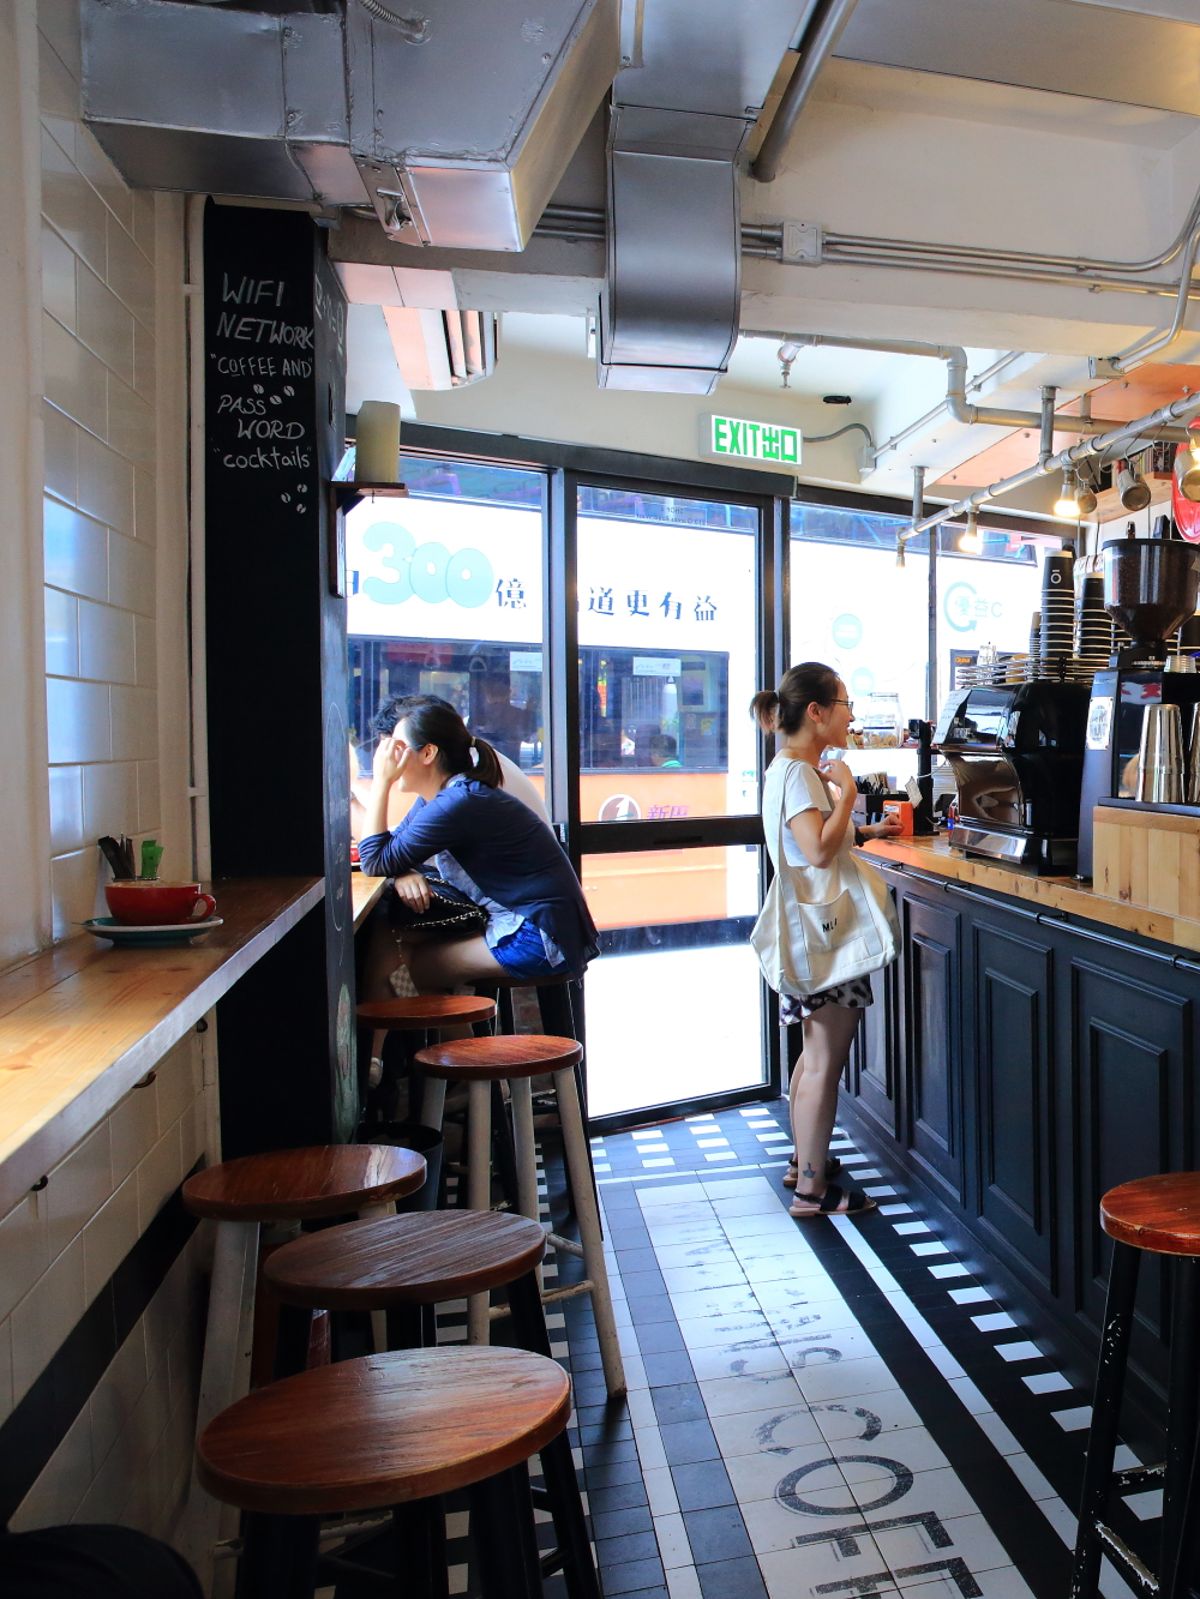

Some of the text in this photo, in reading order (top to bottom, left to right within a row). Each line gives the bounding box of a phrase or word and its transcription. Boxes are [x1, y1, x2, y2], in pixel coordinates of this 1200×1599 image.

[222, 272, 284, 306] WIFI
[216, 312, 314, 349] NETWORK
[217, 394, 266, 415] PASS
[237, 419, 305, 439] WORD
[714, 417, 798, 463] EXIT 出口
[362, 521, 494, 608] 300
